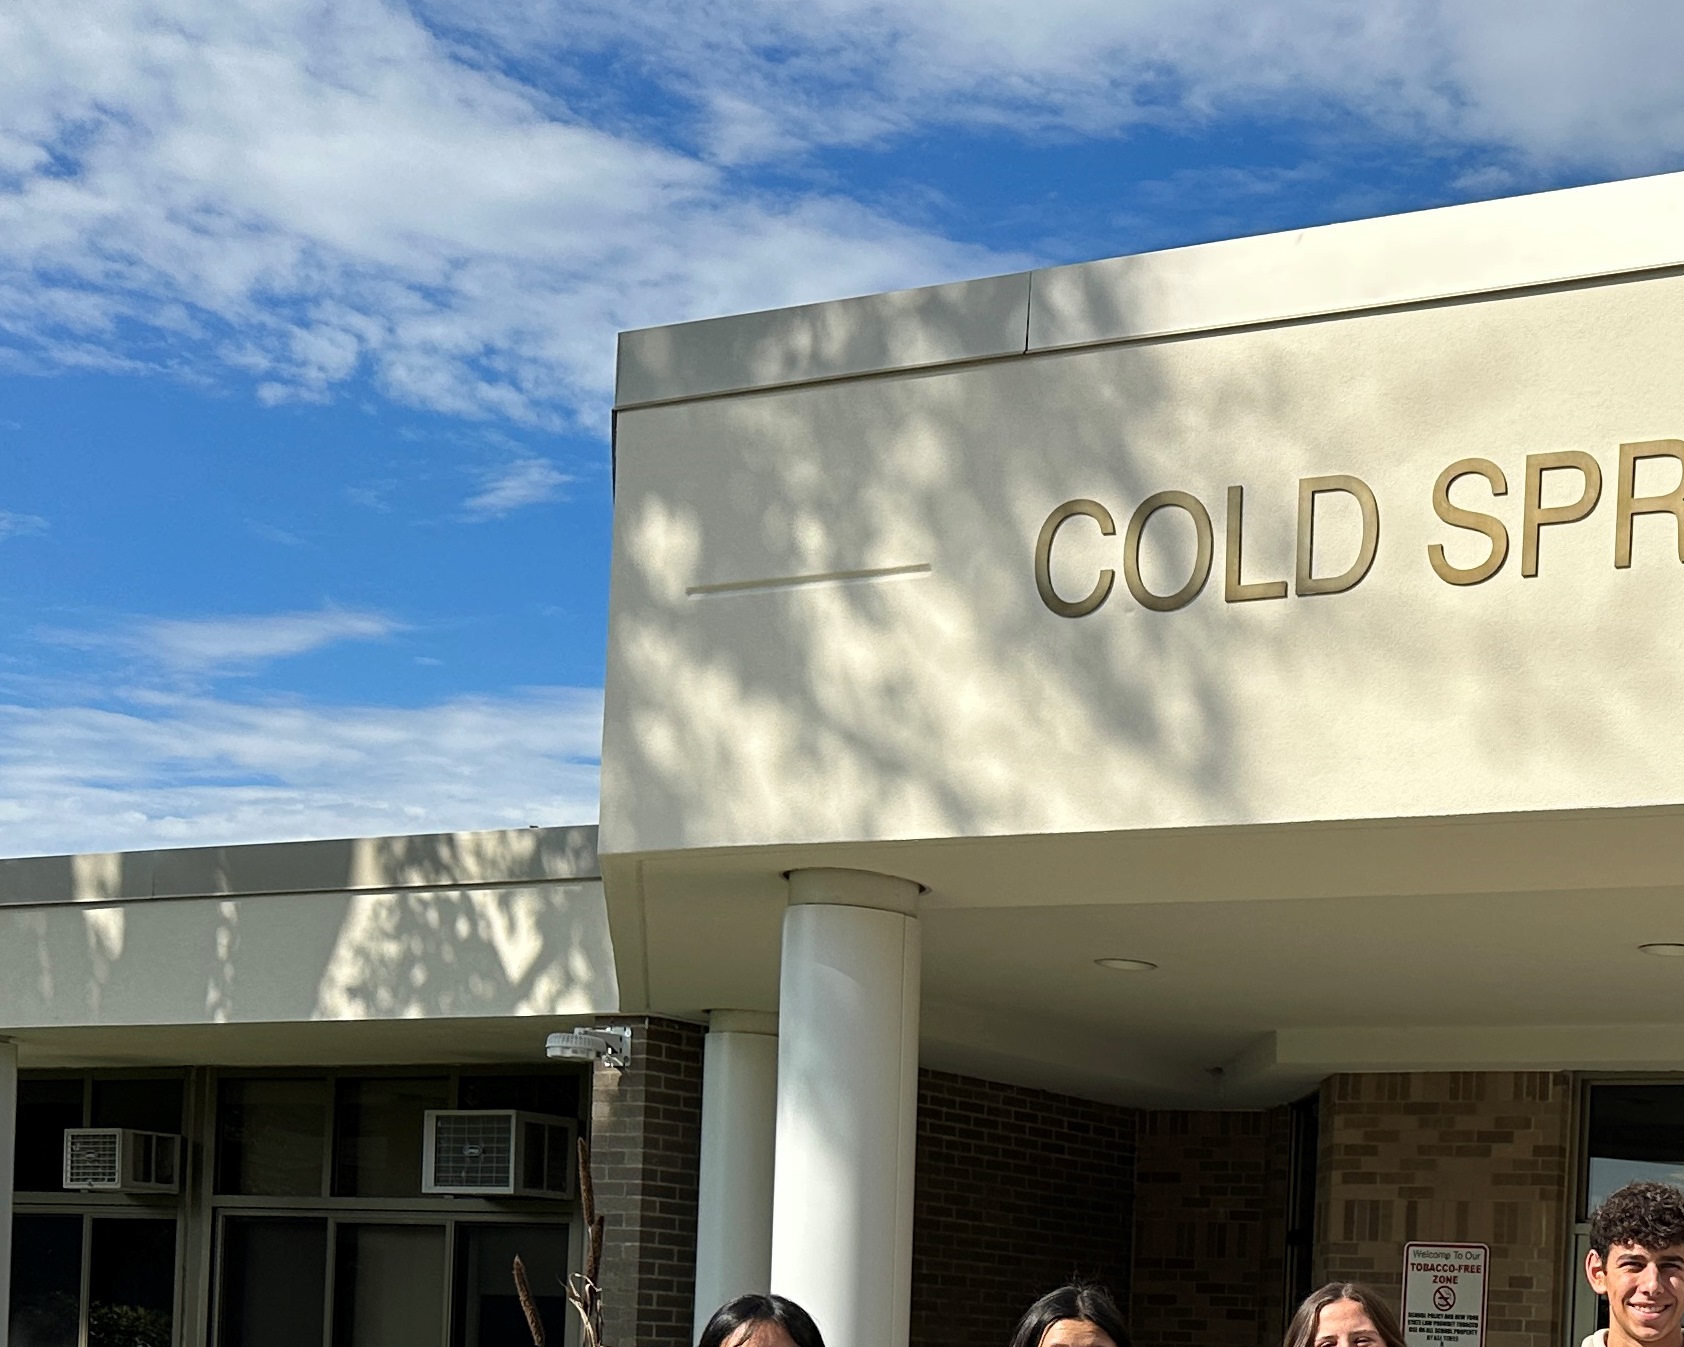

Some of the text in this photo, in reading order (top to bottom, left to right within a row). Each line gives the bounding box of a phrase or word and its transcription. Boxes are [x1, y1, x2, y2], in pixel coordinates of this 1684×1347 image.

[1034, 474, 1380, 618] COLD
[1412, 1250, 1481, 1260] Welcome To Our
[1410, 1262, 1482, 1274] TOBACCO-FREE
[1432, 1275, 1458, 1284] ZONE
